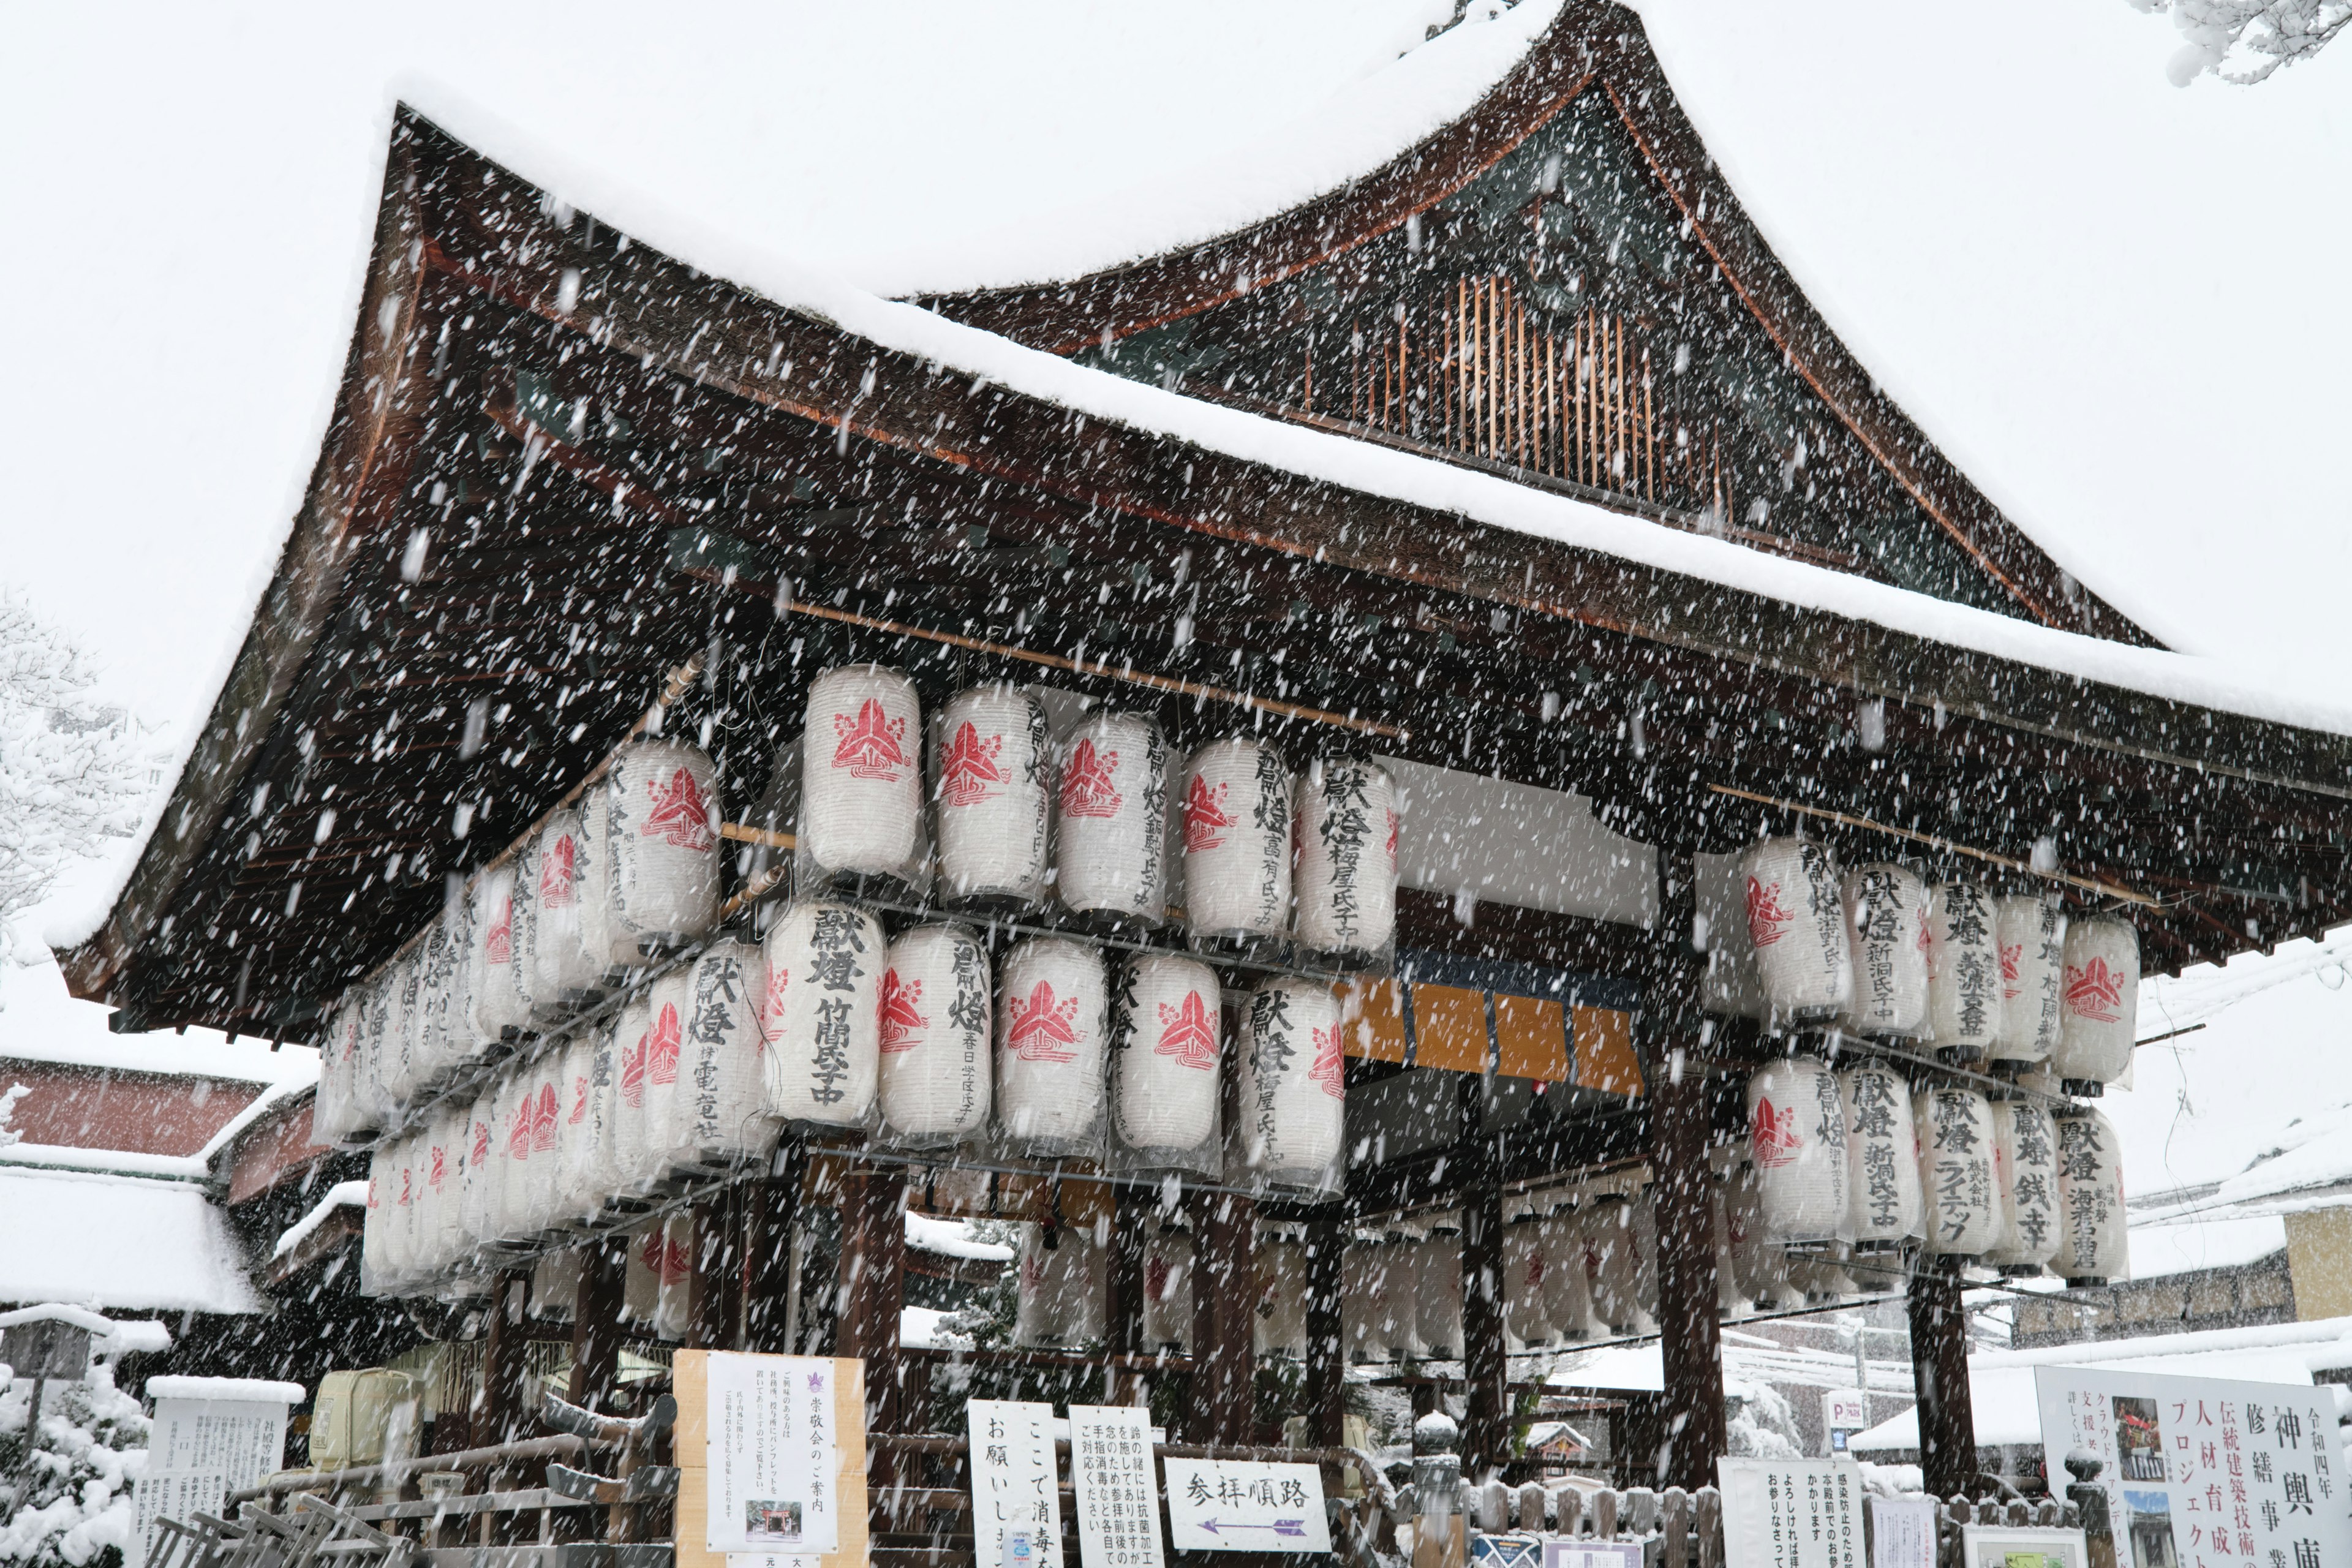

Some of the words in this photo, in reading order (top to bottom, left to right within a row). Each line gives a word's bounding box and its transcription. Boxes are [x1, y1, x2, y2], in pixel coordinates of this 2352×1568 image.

[1967, 1159, 1983, 1207] 株式会社
[756, 1370, 764, 1492] 置いてありますのでご覧下さい。
[769, 1370, 778, 1494] 社務所、授与所にパンフレットを
[782, 1371, 791, 1439] ご興味のある方は
[809, 1396, 825, 1513] 崇敬会のご案内
[2306, 1406, 2332, 1500] 令和四年
[1081, 1425, 1099, 1532] ご対応ください
[1106, 1425, 1128, 1564] 念のため参拝前後の
[1129, 1425, 1153, 1565] 鈴の緒には抗菌加工
[1186, 1472, 1310, 1509] 参拝順路
[1807, 1474, 1821, 1542] かかります
[2195, 1399, 2233, 1556] 人材育成
[2272, 1405, 2322, 1568] 神輿庫
